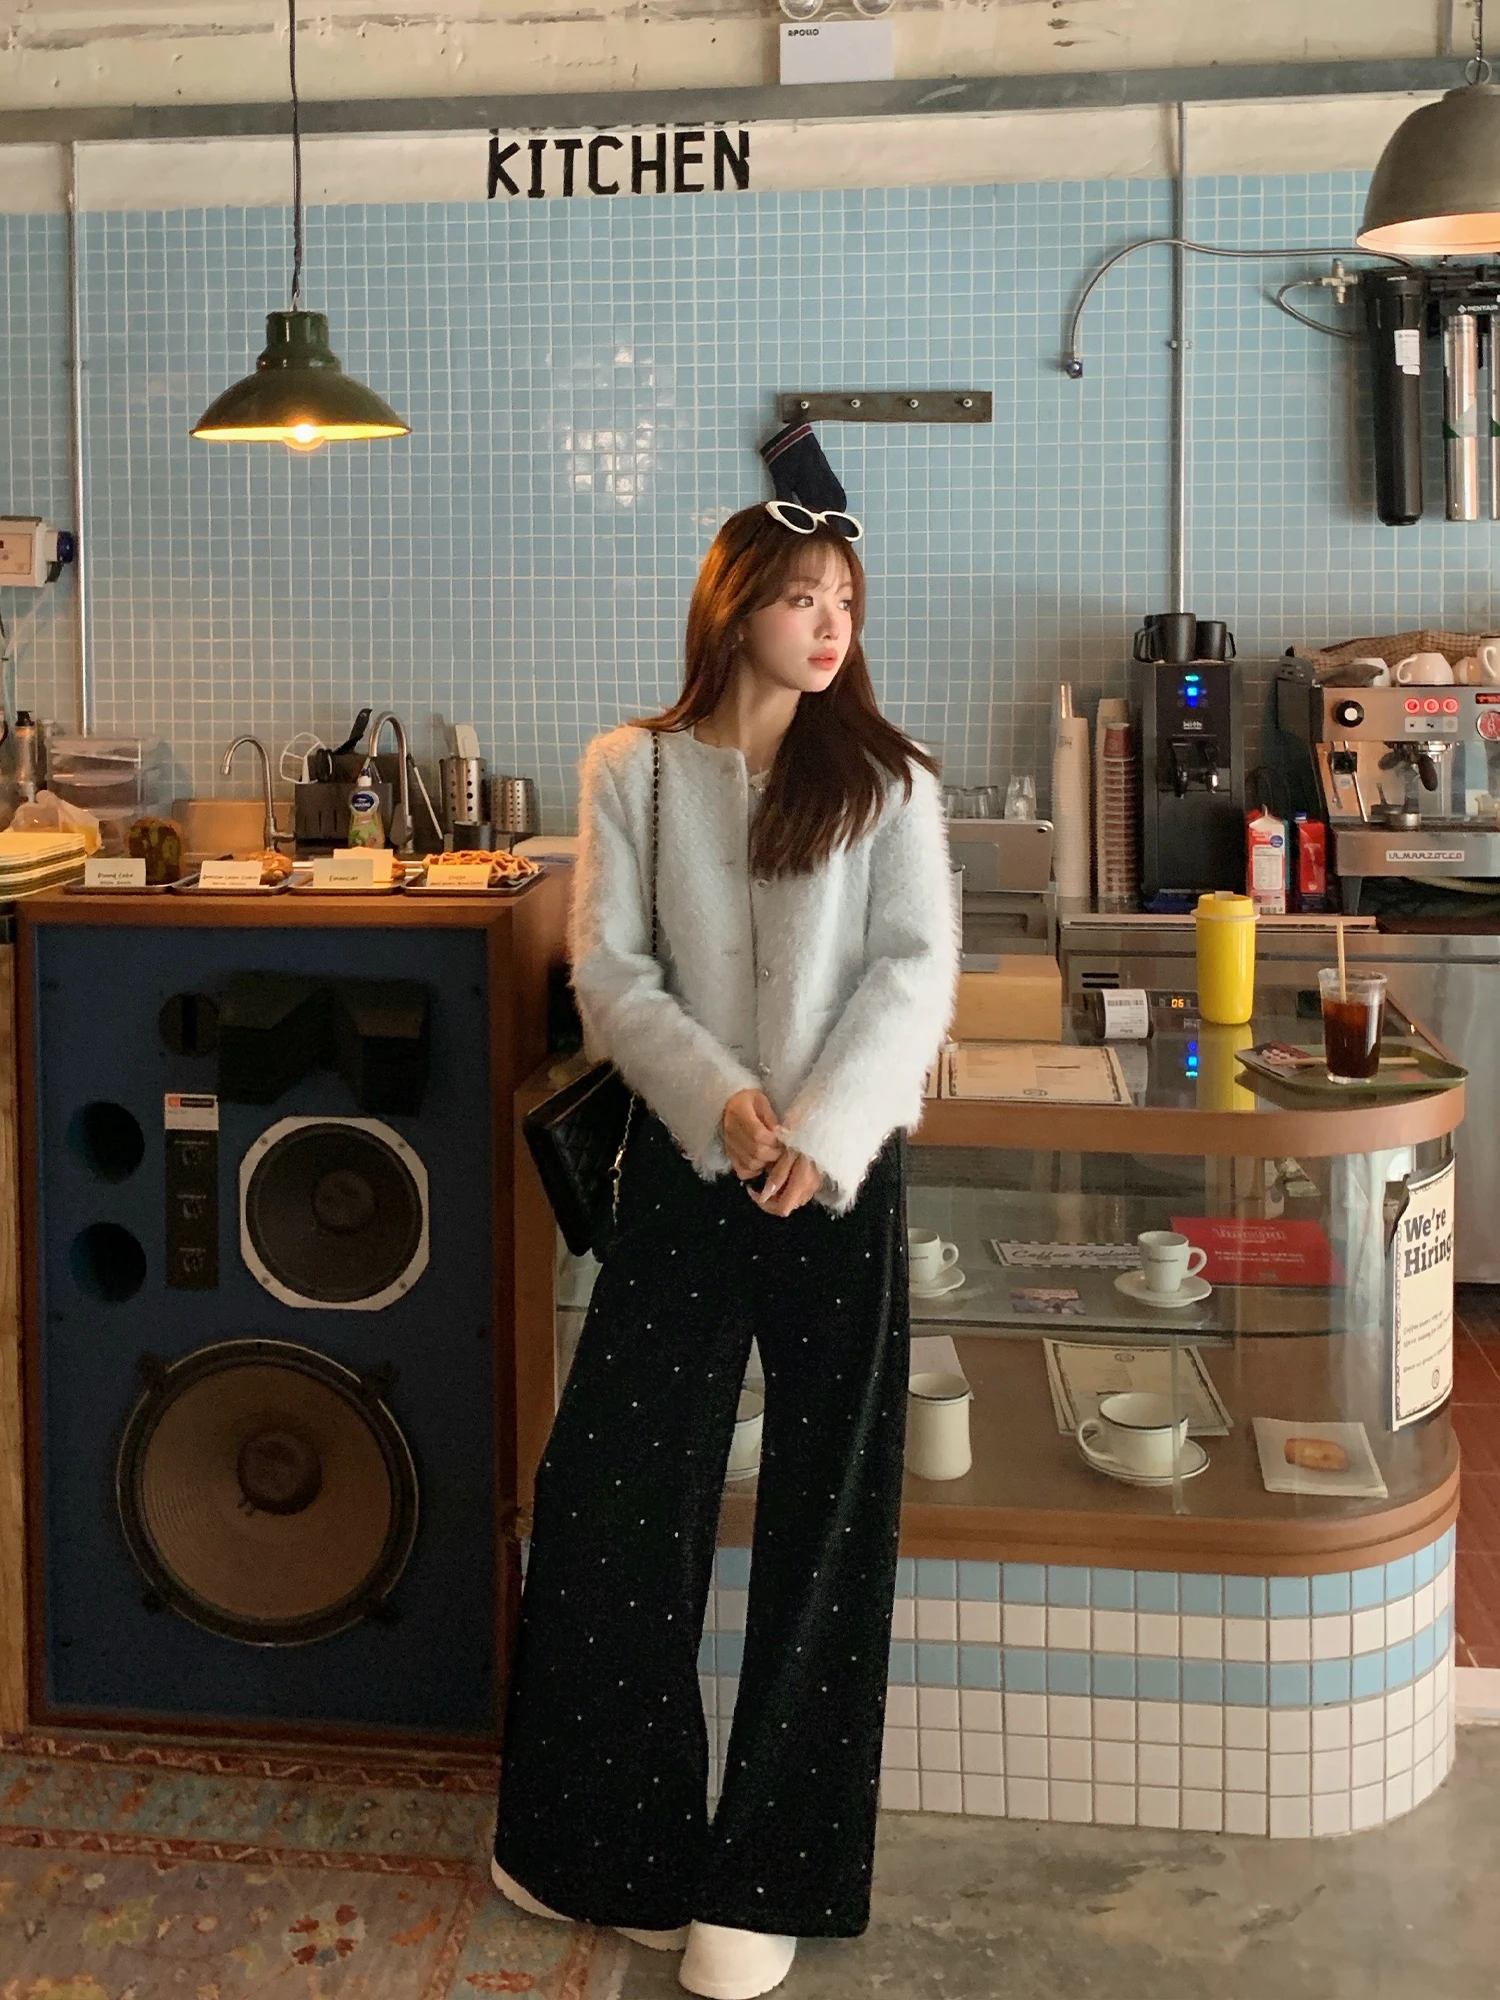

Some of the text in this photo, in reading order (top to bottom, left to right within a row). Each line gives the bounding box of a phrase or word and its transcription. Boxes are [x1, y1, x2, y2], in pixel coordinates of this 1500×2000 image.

[488, 130, 750, 199] KITCHEN
[1404, 1208, 1447, 1243] We're
[1012, 1249, 1072, 1262] Coffee
